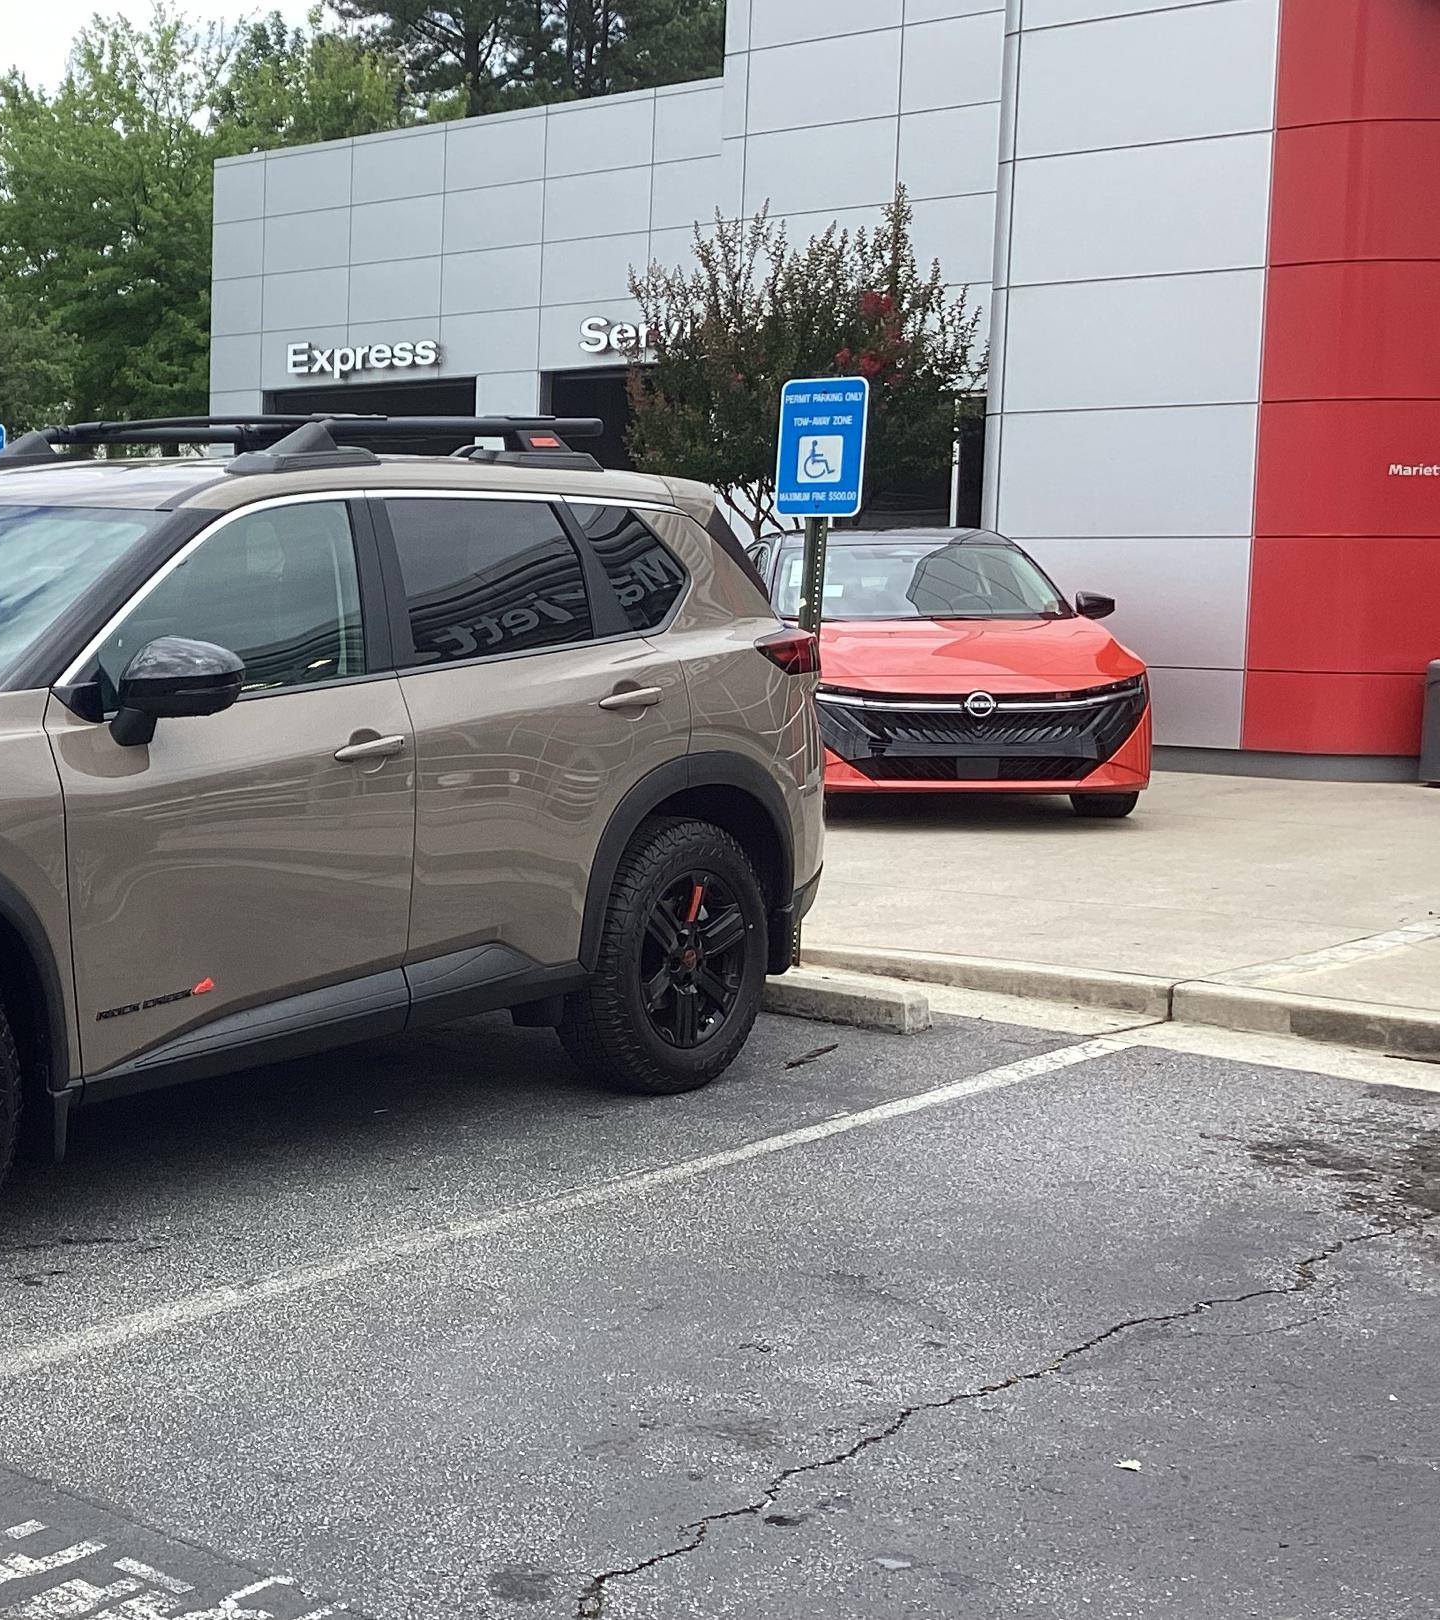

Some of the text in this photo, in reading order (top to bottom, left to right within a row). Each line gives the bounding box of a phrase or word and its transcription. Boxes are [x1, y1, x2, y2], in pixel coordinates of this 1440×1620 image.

[287, 339, 437, 379] Express
[785, 391, 864, 404] PERMIT PARKING ONLY
[793, 415, 853, 427] TOW-AWAY ZONE
[779, 491, 857, 502] MAXIMUM FINE $500.00
[96, 988, 192, 1021] ROCK CREEK
